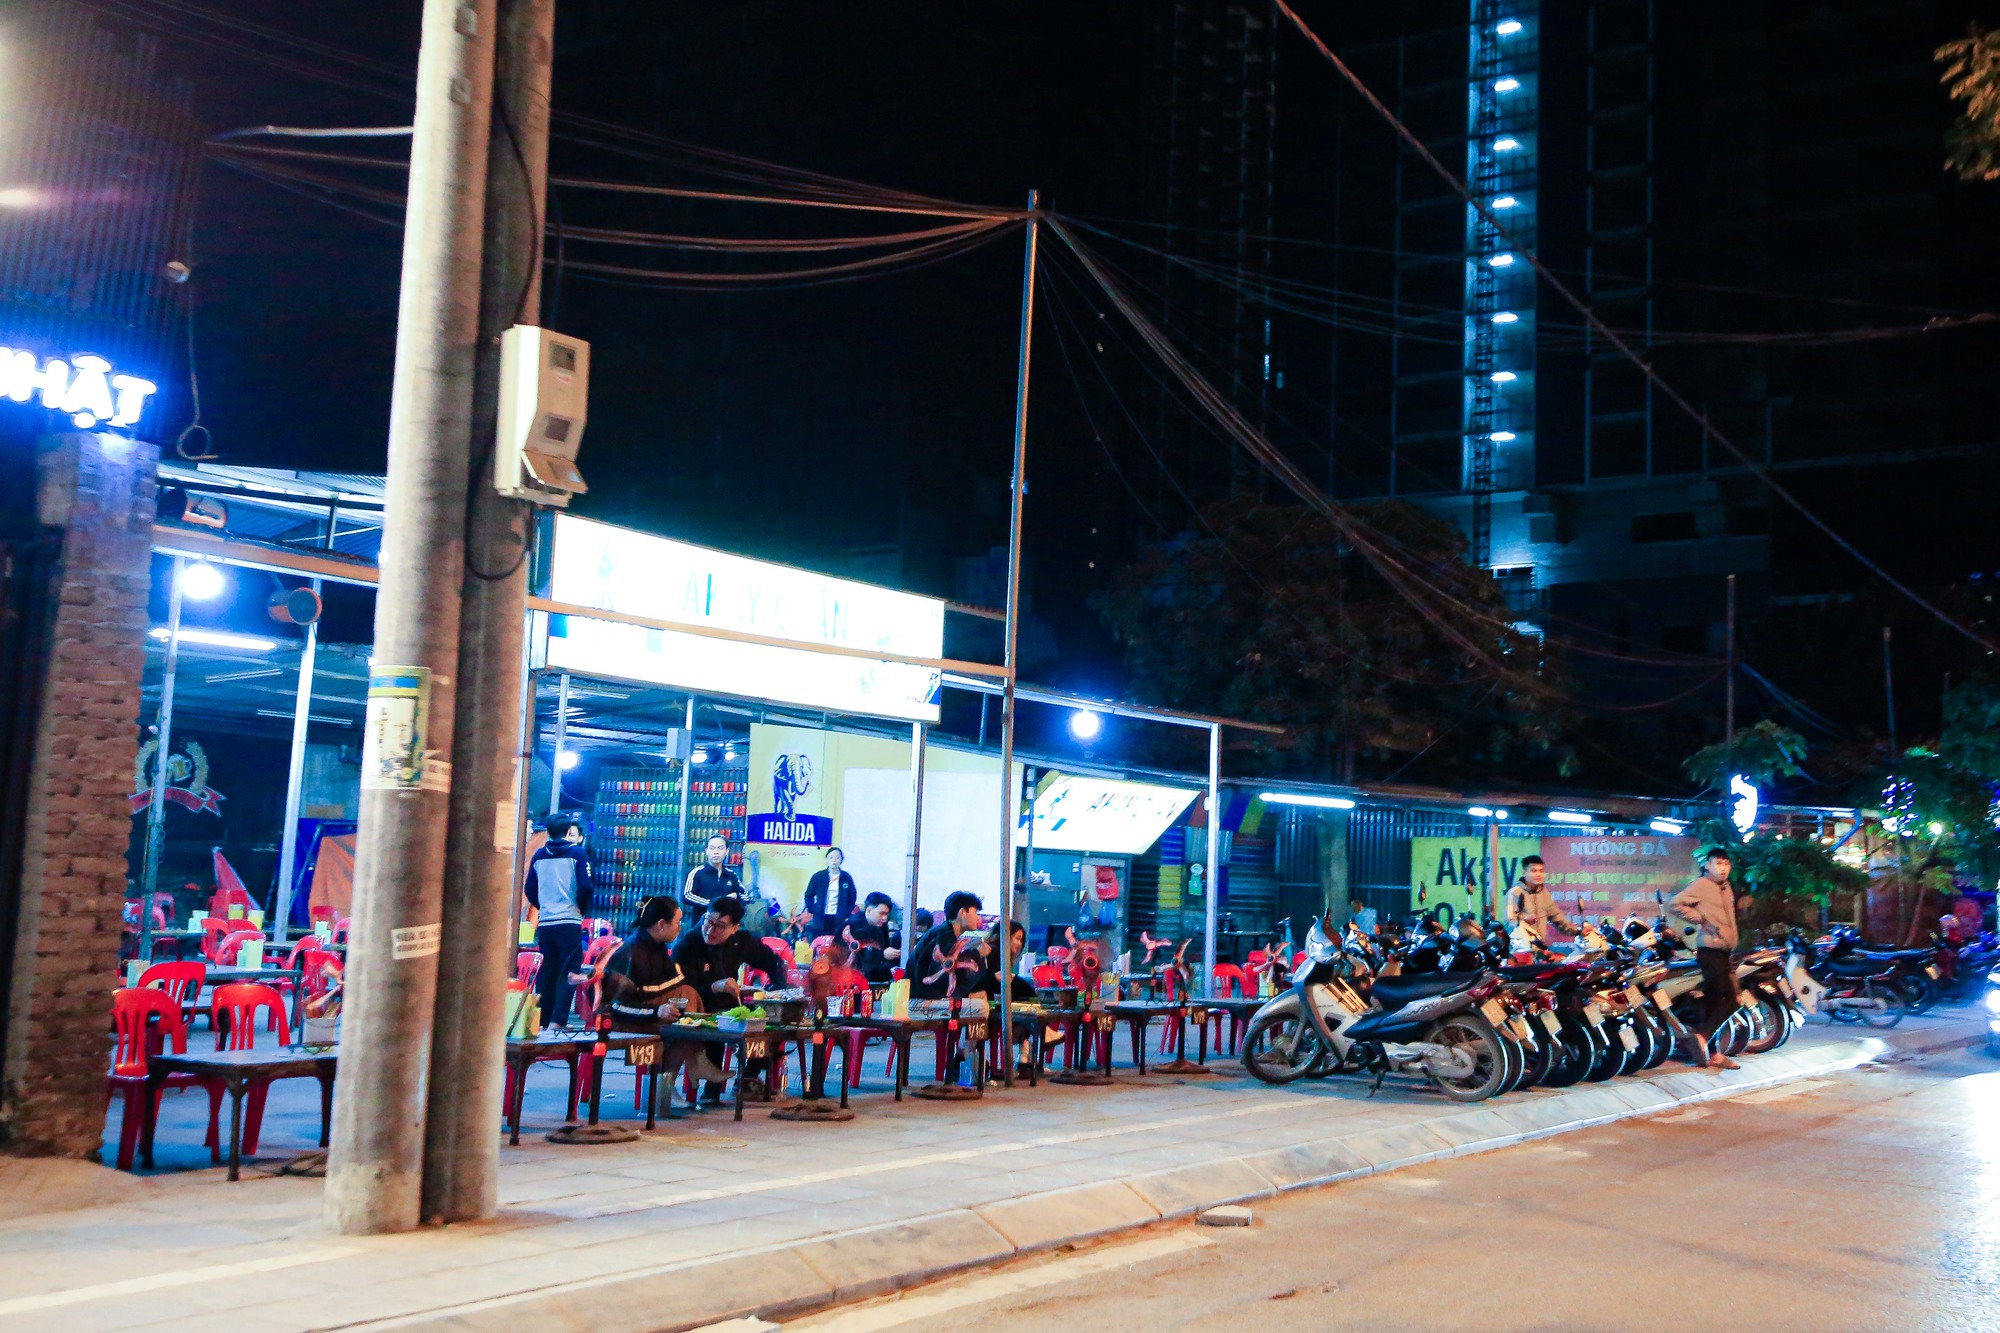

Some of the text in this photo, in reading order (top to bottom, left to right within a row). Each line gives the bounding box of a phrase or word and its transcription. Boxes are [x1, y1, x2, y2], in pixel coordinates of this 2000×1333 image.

[764, 821, 815, 842] HALIDA
[968, 1023, 986, 1039] V16
[630, 1044, 655, 1066] V19
[745, 1041, 766, 1059] V18
